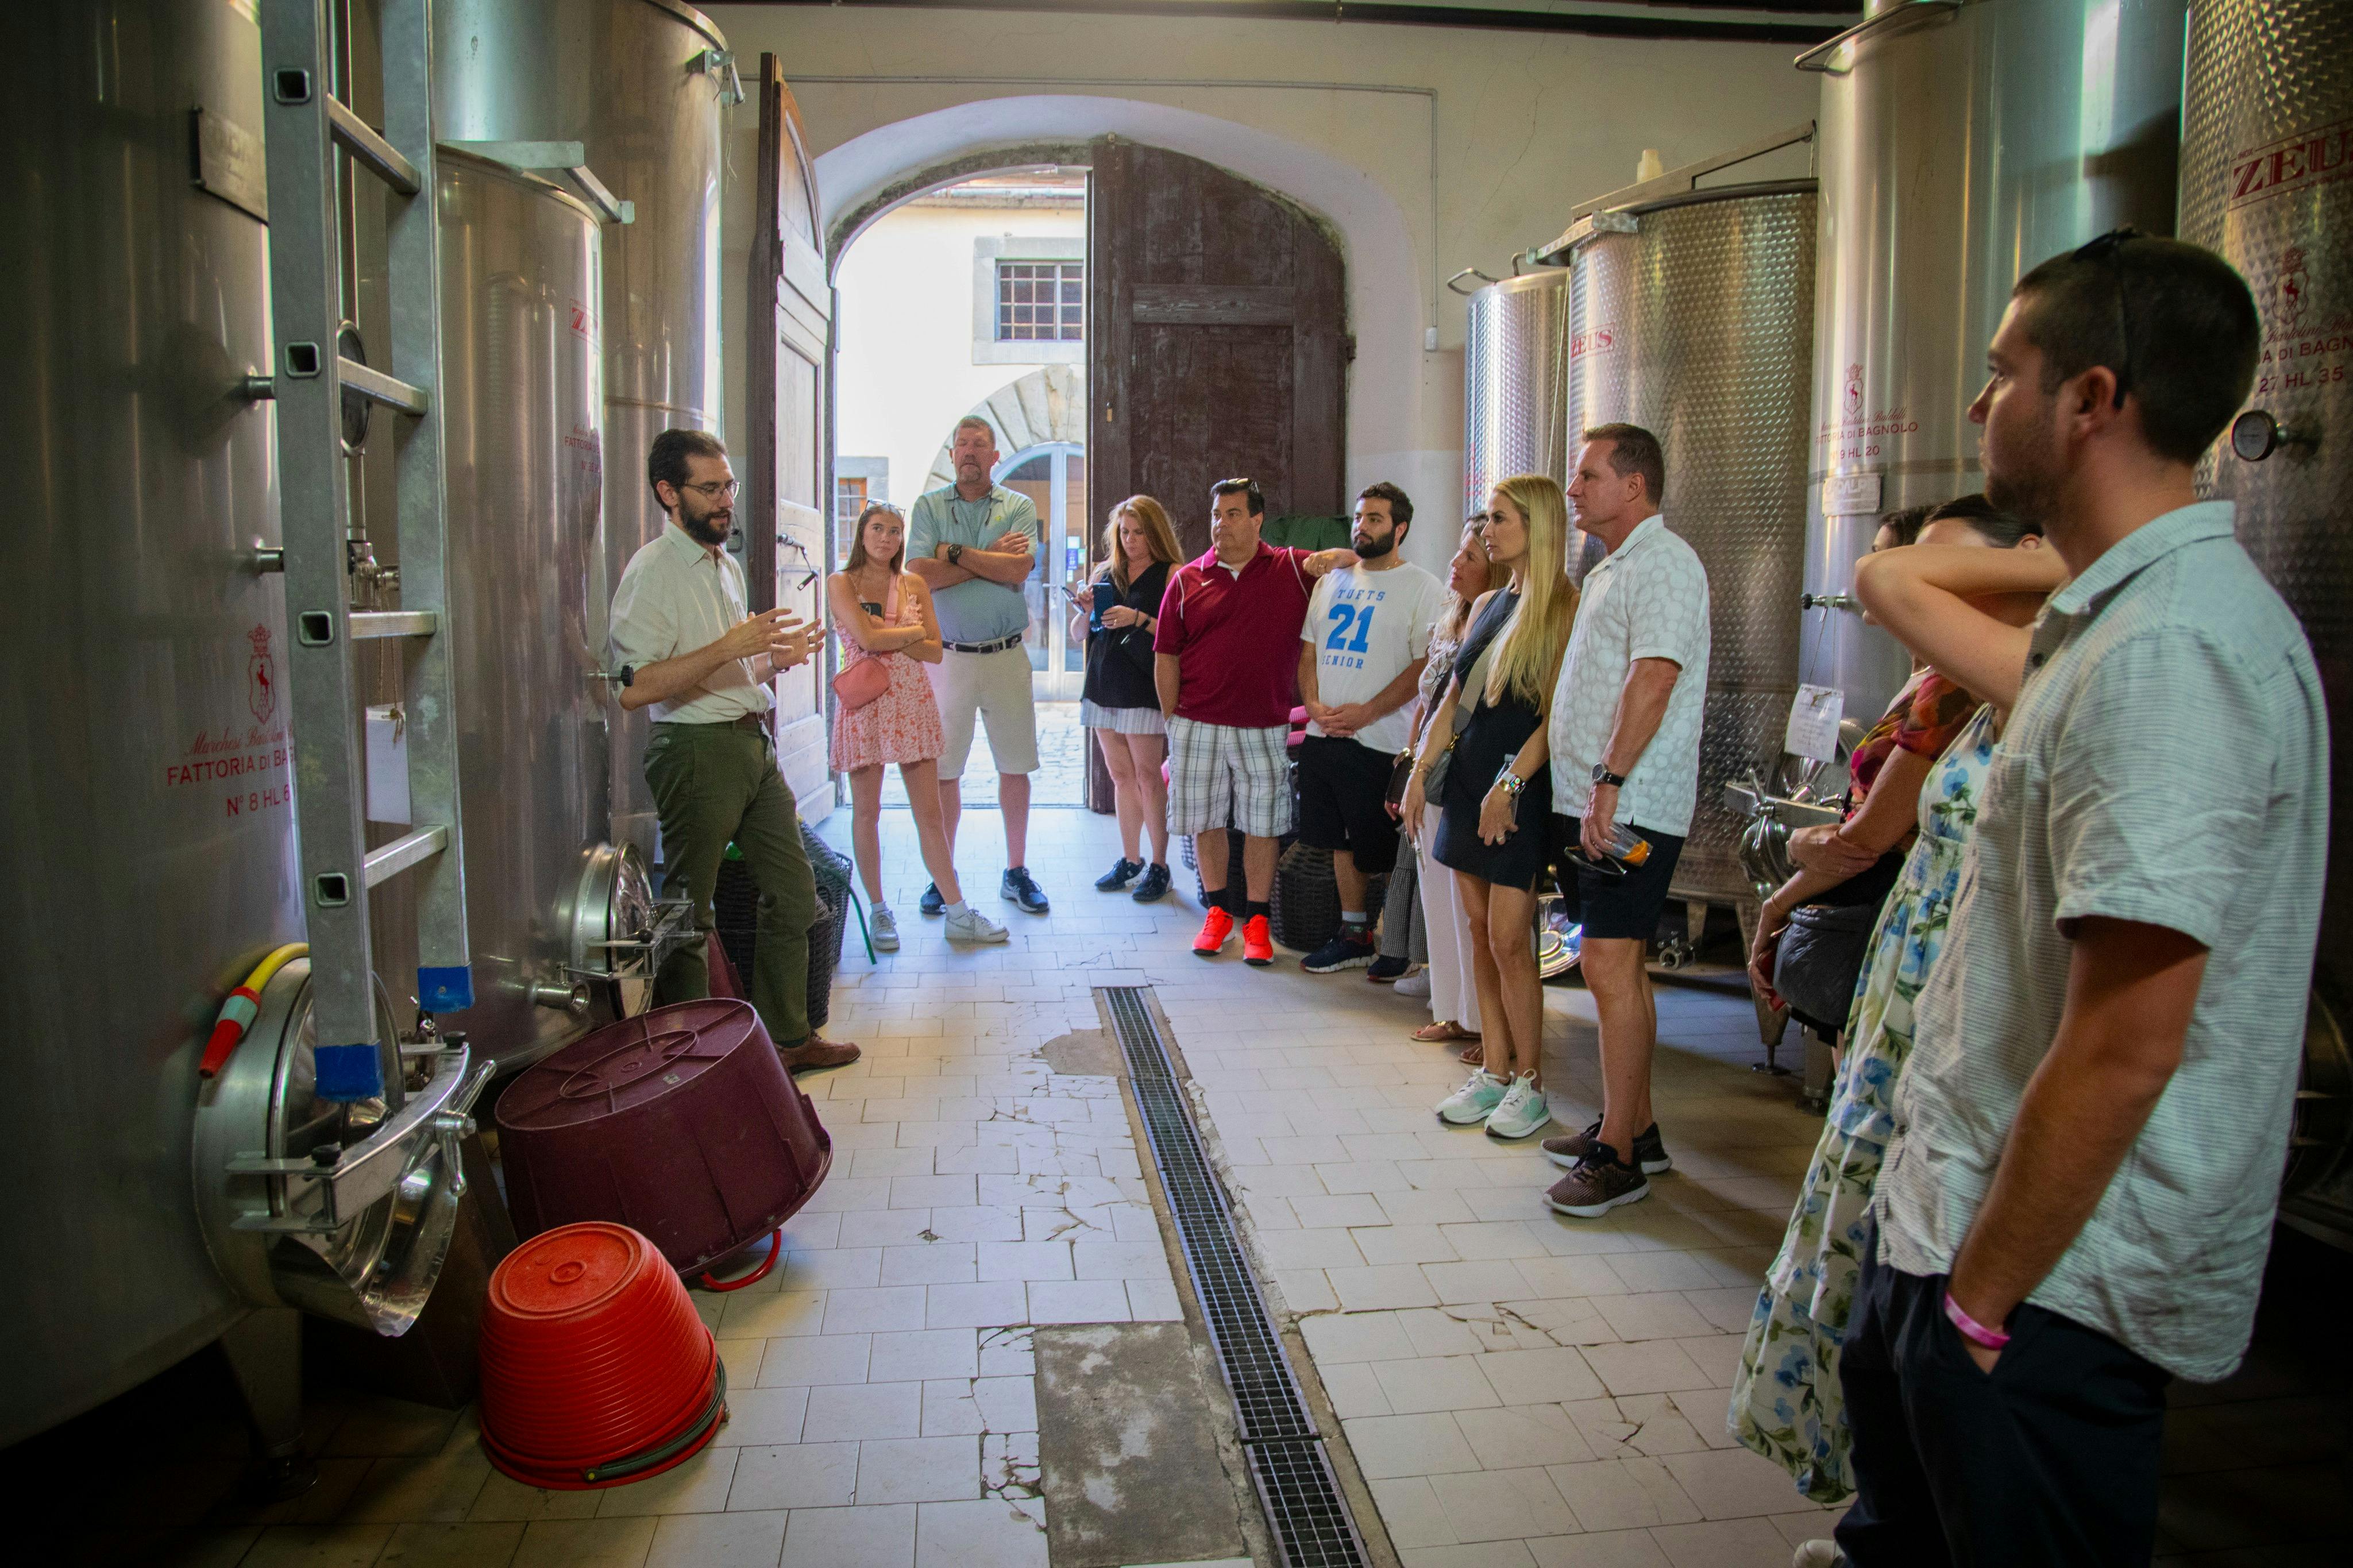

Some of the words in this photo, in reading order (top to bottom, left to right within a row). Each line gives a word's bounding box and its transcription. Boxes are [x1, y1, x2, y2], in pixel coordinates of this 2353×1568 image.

[2232, 130, 2353, 199] ZEU
[2279, 348, 2293, 360] DI
[2259, 376, 2279, 392] 27
[2286, 372, 2310, 388] HL
[2319, 365, 2344, 383] 35
[1847, 431, 1856, 439] DI
[1858, 422, 1918, 437] BAGNOLO
[1840, 449, 1845, 459] 9
[1849, 447, 1861, 458] HL
[1866, 445, 1880, 456] 20
[1337, 589, 1385, 601] TUFTS
[1326, 604, 1375, 653] 21
[167, 755, 255, 786] FATTORIA
[260, 755, 271, 770] DI
[249, 793, 258, 811] 8
[264, 789, 280, 808] HL
